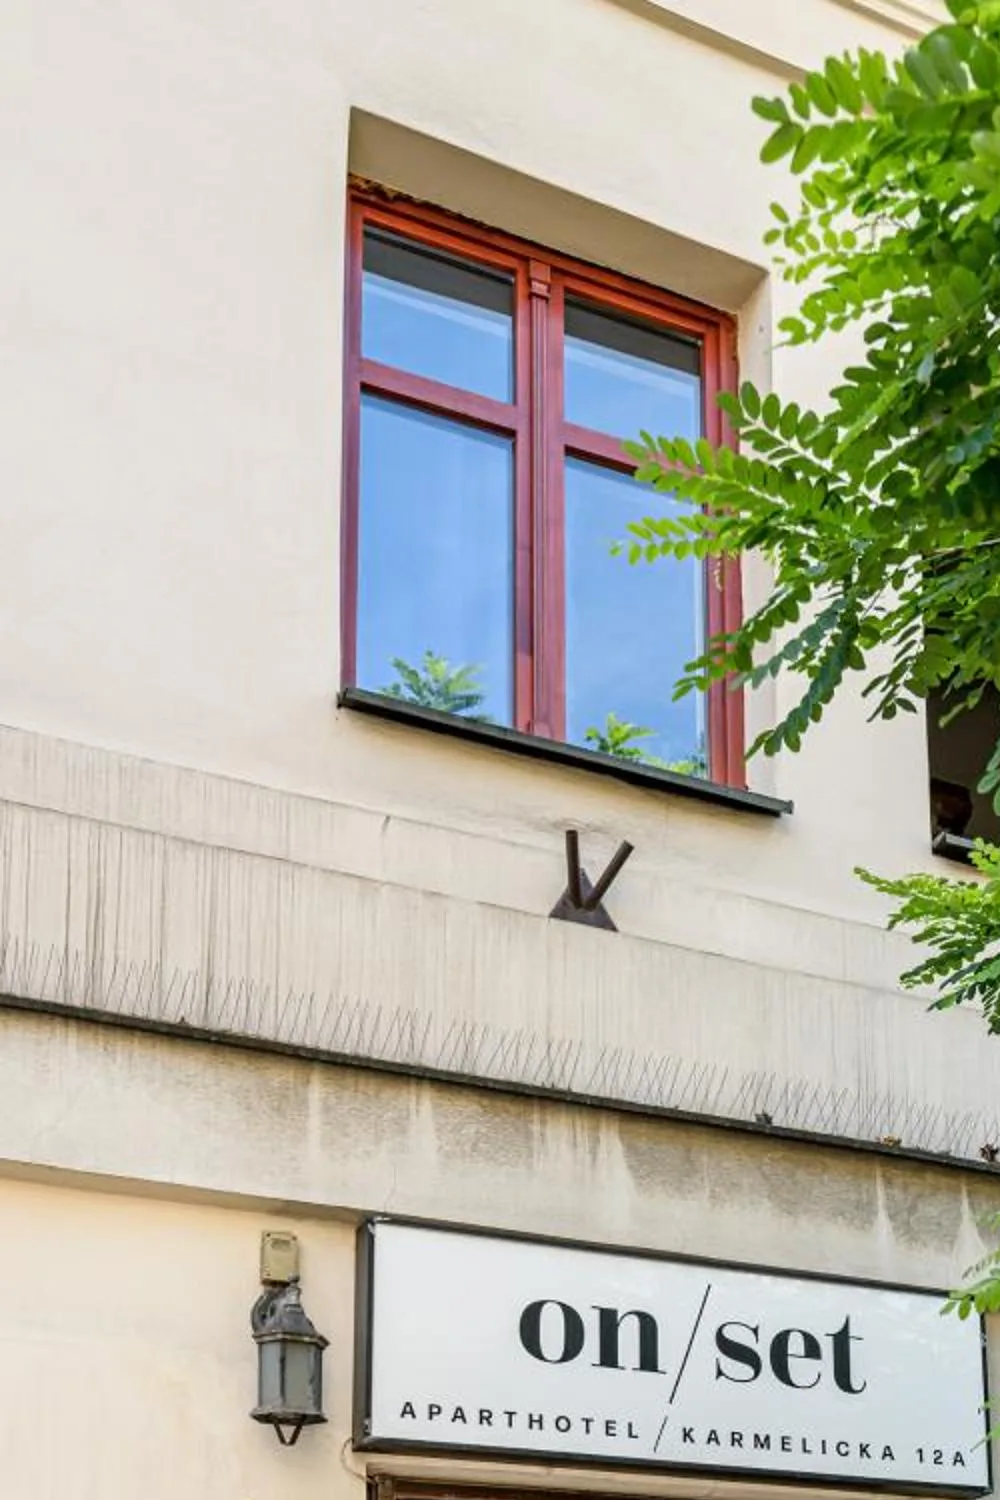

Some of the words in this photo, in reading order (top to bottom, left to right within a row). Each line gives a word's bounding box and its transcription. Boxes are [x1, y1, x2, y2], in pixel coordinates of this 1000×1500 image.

[399, 1400, 641, 1440] APARTHOTEL
[681, 1426, 896, 1462] KARMELICKA
[916, 1447, 967, 1468] 12A
